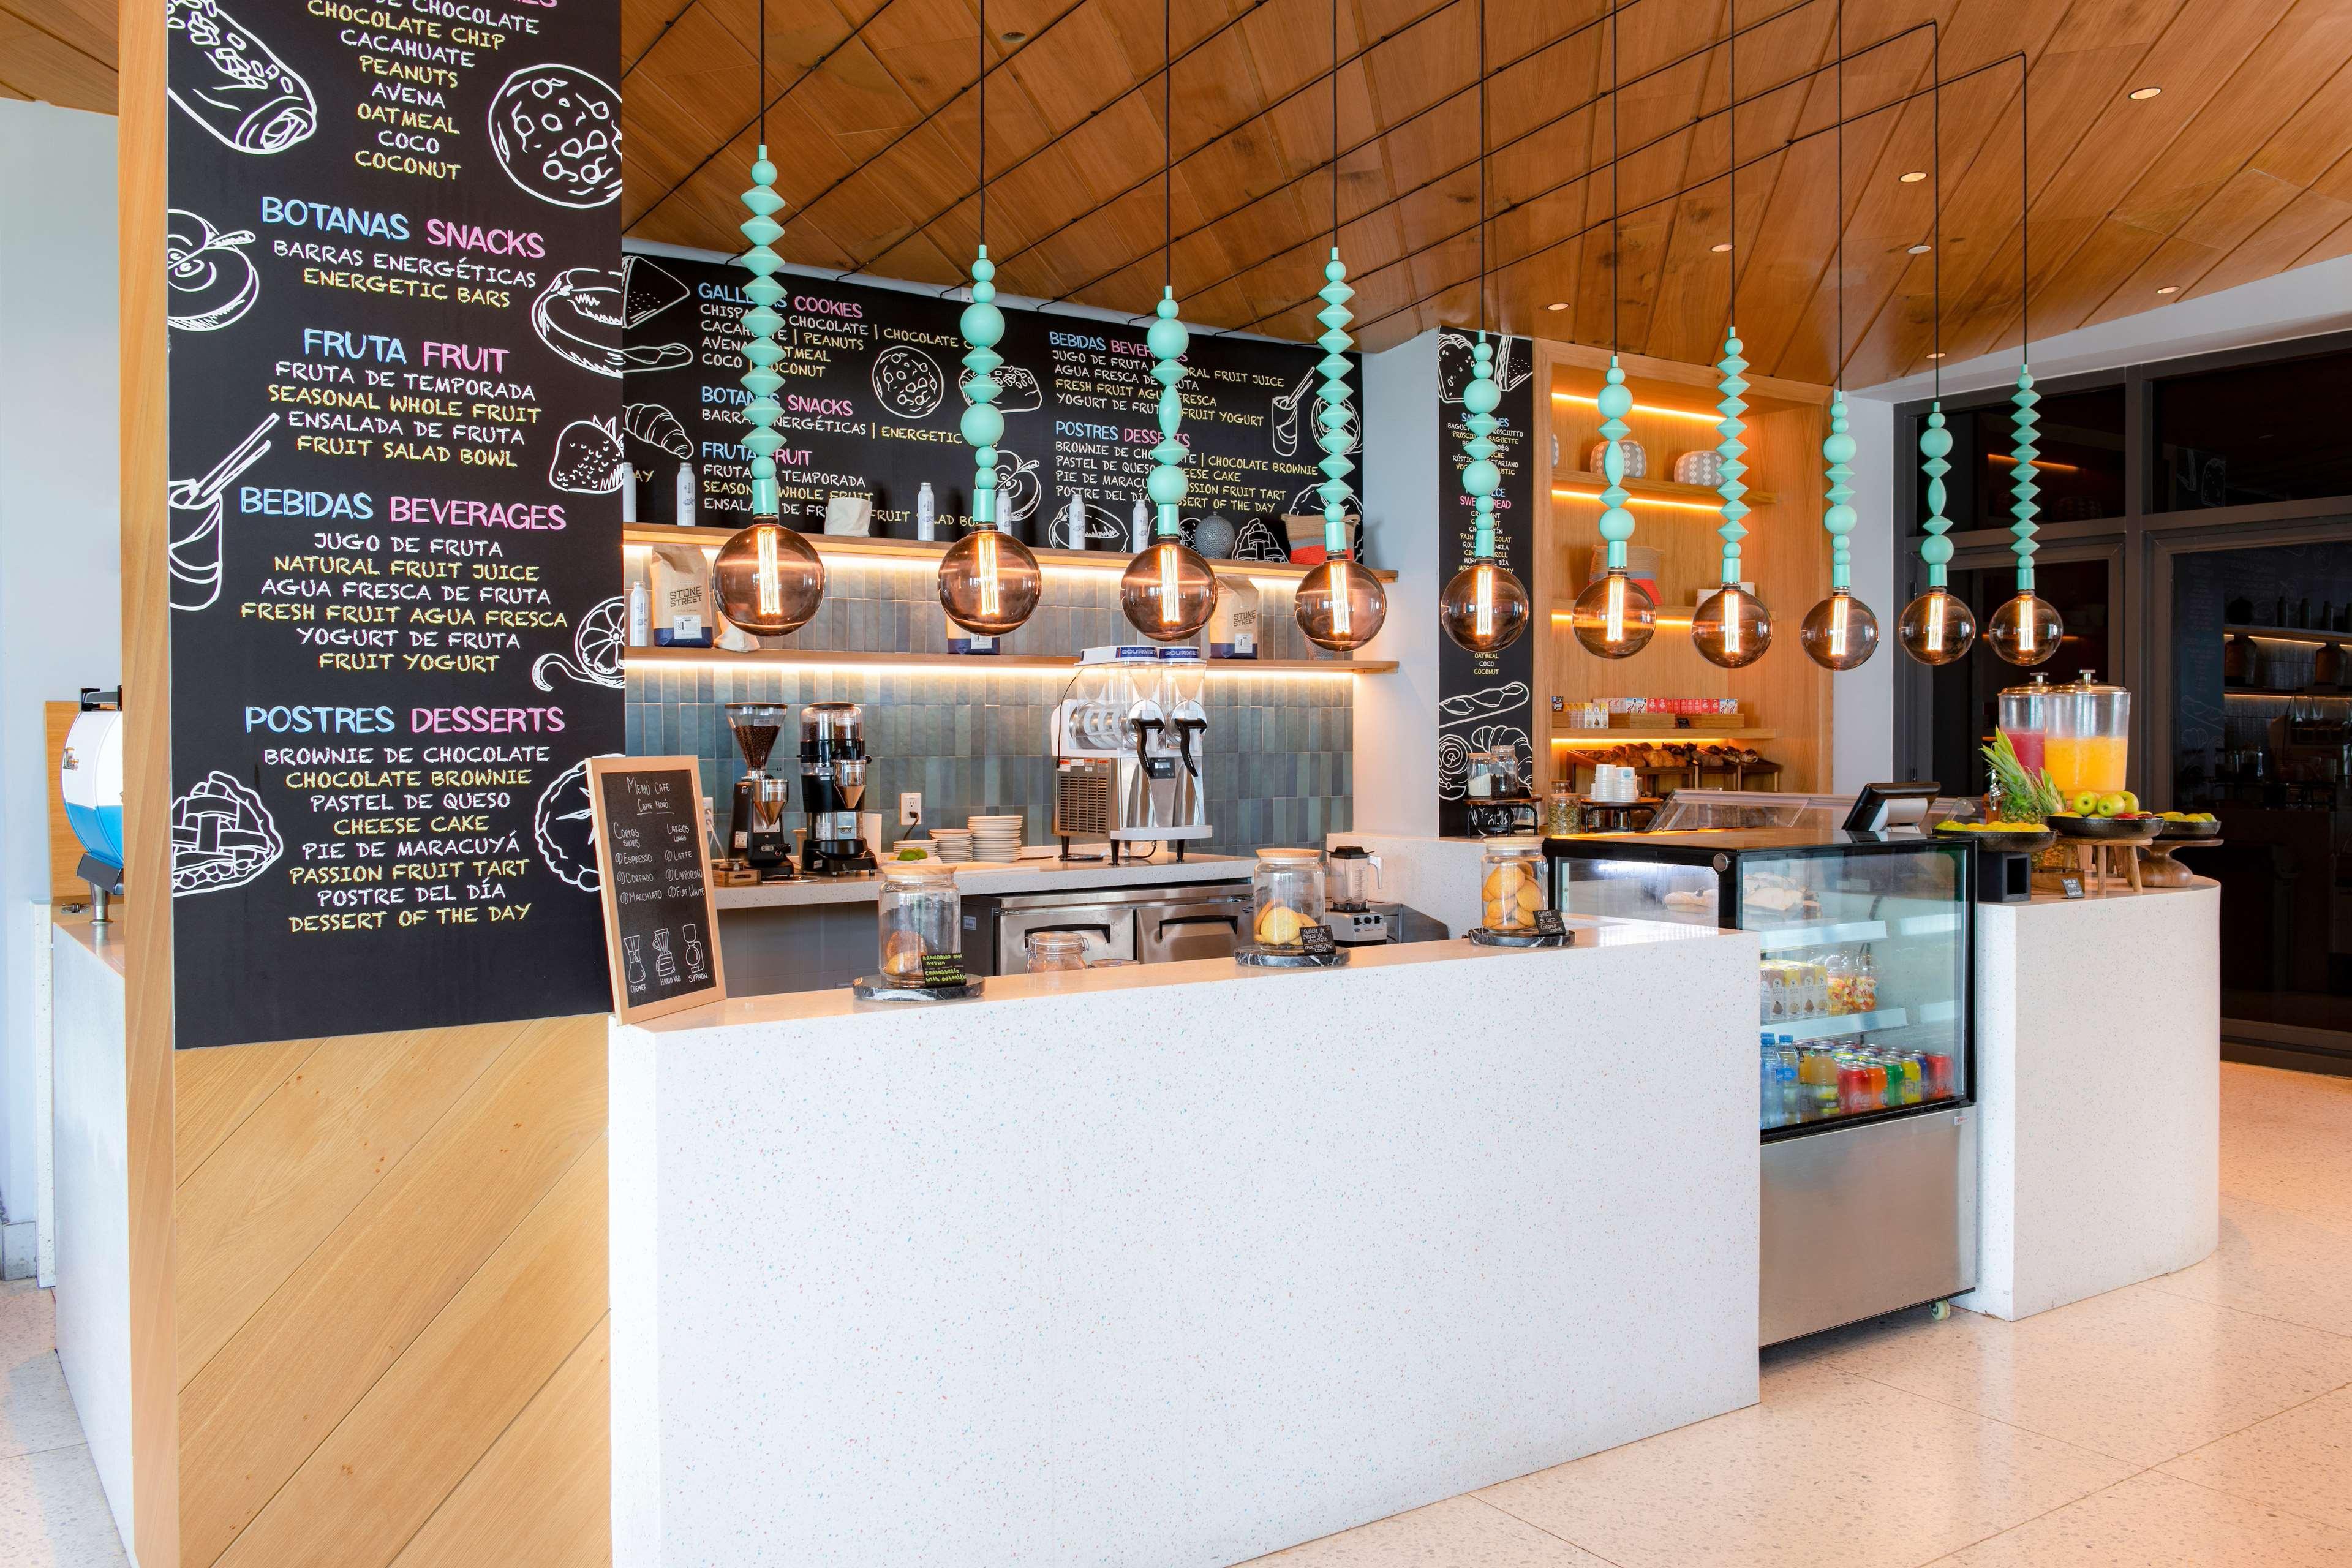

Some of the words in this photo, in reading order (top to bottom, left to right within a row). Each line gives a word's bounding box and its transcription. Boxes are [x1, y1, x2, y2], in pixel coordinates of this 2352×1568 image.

[308, 0, 441, 38] CHOCOLATE
[451, 28, 505, 50] CHIP
[412, 0, 540, 35] CHOCOLATE
[341, 28, 475, 68] CACAHUATE
[359, 55, 458, 88] PEANUTS
[372, 82, 445, 108] AVENA
[358, 103, 459, 134] OATMEAL
[378, 130, 439, 154] COCO
[355, 151, 461, 179] COCONUT
[262, 197, 409, 240] BOTANAS
[427, 219, 545, 258] SNACKS
[274, 240, 363, 266] BARRAS
[374, 253, 535, 288] ENERGÉTICAS
[304, 268, 447, 300] ENERGETIC
[458, 287, 510, 307] BARS
[794, 296, 862, 318] COOKIES
[789, 315, 868, 335] CHOCOLATE
[884, 328, 959, 347] CHOCOLATE
[804, 333, 864, 350] PEANUTS
[1050, 332, 1106, 350] BEBIDAS
[304, 328, 407, 364] FRUTA
[423, 341, 510, 374] FRUIT
[702, 353, 742, 368] COCO
[276, 361, 354, 383] FRUTA
[365, 370, 394, 387] DE
[404, 373, 535, 401] TEMPORADA
[1052, 350, 1085, 363] JUGO
[1091, 355, 1106, 365] DE
[1111, 358, 1148, 371] FRUTA
[1215, 371, 1248, 382] FRUIT
[1253, 375, 1284, 387] JUICE
[1055, 364, 1089, 377] AGUA
[1095, 369, 1139, 383] FRESCA
[1142, 371, 1158, 385] DE
[1056, 379, 1091, 391] FRESH
[1097, 384, 1133, 396] FRUIT
[268, 384, 380, 410] SEASONAL
[390, 395, 462, 417] WHOLE
[472, 404, 541, 423] FRUIT
[788, 394, 853, 419] SNACKS
[1057, 393, 1107, 409] YOGURT
[1112, 400, 1127, 410] DE
[1182, 408, 1215, 420] FRUIT
[1219, 412, 1264, 426] YOGURT
[288, 411, 403, 435] ENSALADA
[413, 421, 442, 438] DE
[453, 425, 524, 445] FRUTA
[882, 426, 962, 444] ENERGETIC
[1056, 421, 1118, 440] POSTRES
[297, 435, 373, 456] FRUIT
[383, 442, 450, 461] SALAD
[461, 449, 517, 467] BOWL
[1056, 441, 1109, 455] BROWNIE
[1114, 447, 1128, 457] DE
[1208, 456, 1268, 470] CHOCOLATE
[1273, 462, 1318, 475] BROWNIE
[703, 464, 752, 478] FRUTA
[782, 470, 865, 487] TEMPORADA
[1056, 456, 1097, 469] PASTEL
[1102, 461, 1117, 470] DE
[1214, 471, 1241, 482] CAKE
[1056, 470, 1077, 482] PIE
[1082, 473, 1097, 483] DE
[1223, 486, 1256, 497] FRUIT
[1260, 489, 1286, 500] TART
[241, 487, 373, 519] BEBIDAS
[391, 497, 566, 530] BEVERAGES
[782, 503, 800, 514] DE
[1056, 486, 1099, 499] POSTRE
[1105, 490, 1126, 500] DEL
[1213, 499, 1227, 508] OF
[1231, 500, 1250, 511] THE
[1255, 502, 1275, 513] DAY
[315, 533, 380, 551] JUGO
[391, 537, 420, 552] DE
[430, 539, 502, 557] FRUTA
[275, 555, 380, 575] NATURAL
[391, 560, 462, 578] FRUIT
[473, 564, 539, 581] JUICE
[261, 579, 331, 597] AGUA
[342, 582, 431, 600] FRESCA
[442, 586, 470, 601] DE
[480, 587, 550, 605] FRUTA
[670, 586, 702, 600] STONE
[670, 595, 702, 607] STREET
[241, 603, 314, 620] FRESH
[326, 605, 401, 623] FRUIT
[410, 608, 475, 625] AGUA
[485, 611, 567, 627] FRESCA
[1234, 610, 1256, 620] STONE
[1234, 617, 1256, 627] STREET
[296, 628, 398, 647] YOGURT
[409, 631, 438, 647] DE
[448, 632, 520, 649] FRUTA
[319, 653, 394, 670] FRUIT
[403, 654, 500, 672] YOGURT
[246, 706, 394, 733] POSTRES
[412, 706, 565, 733] DESSERTS
[265, 747, 373, 766] BROWNIE
[384, 748, 413, 763] DE
[423, 746, 549, 763] CHOCOLATE
[286, 771, 421, 788] CHOCOLATE
[432, 769, 531, 786] BROWNIE
[311, 794, 394, 812] PASTEL
[404, 794, 433, 809] DE
[443, 792, 510, 810] QUESO
[334, 818, 421, 835] CHEESE
[431, 815, 489, 832] CAKE
[303, 843, 345, 860] PIE
[356, 842, 385, 858] DE
[397, 830, 519, 858] MARACUYÁ
[290, 865, 382, 884] PASSION
[393, 862, 464, 880] FRUIT
[473, 859, 530, 876] TART
[317, 888, 405, 907] POSTRE
[415, 885, 456, 902] DEL
[467, 876, 505, 899] DÍA
[289, 911, 387, 932] DESSERT
[399, 910, 428, 927] OF
[436, 907, 478, 924] THE
[488, 903, 531, 921] DAY
